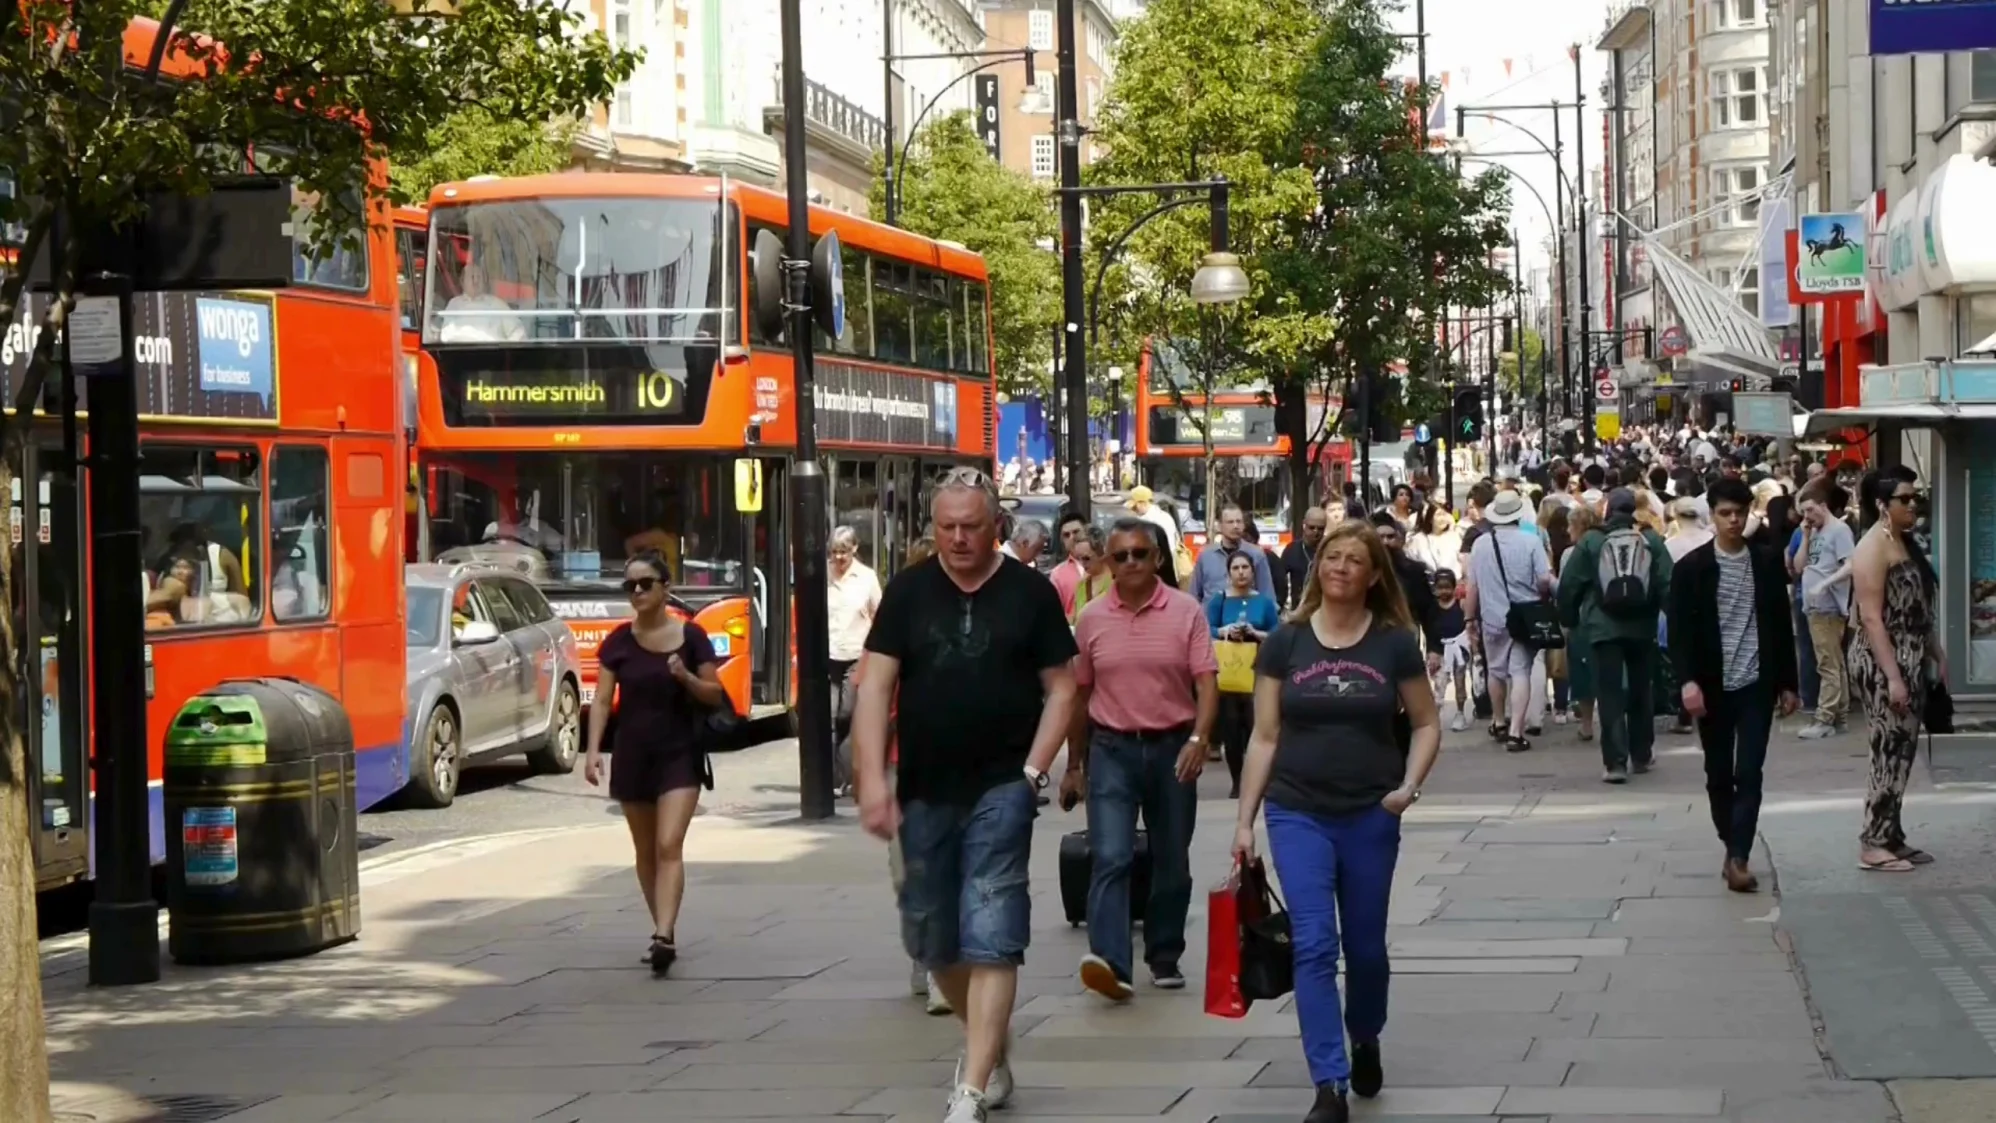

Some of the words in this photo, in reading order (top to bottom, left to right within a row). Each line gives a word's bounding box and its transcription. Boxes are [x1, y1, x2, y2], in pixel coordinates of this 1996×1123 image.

[1806, 277, 1839, 289] Lloyds
[200, 305, 260, 356] wonga
[204, 363, 215, 382] for
[216, 365, 250, 385] business
[466, 379, 605, 402] Hammersmith
[638, 372, 672, 407] 10
